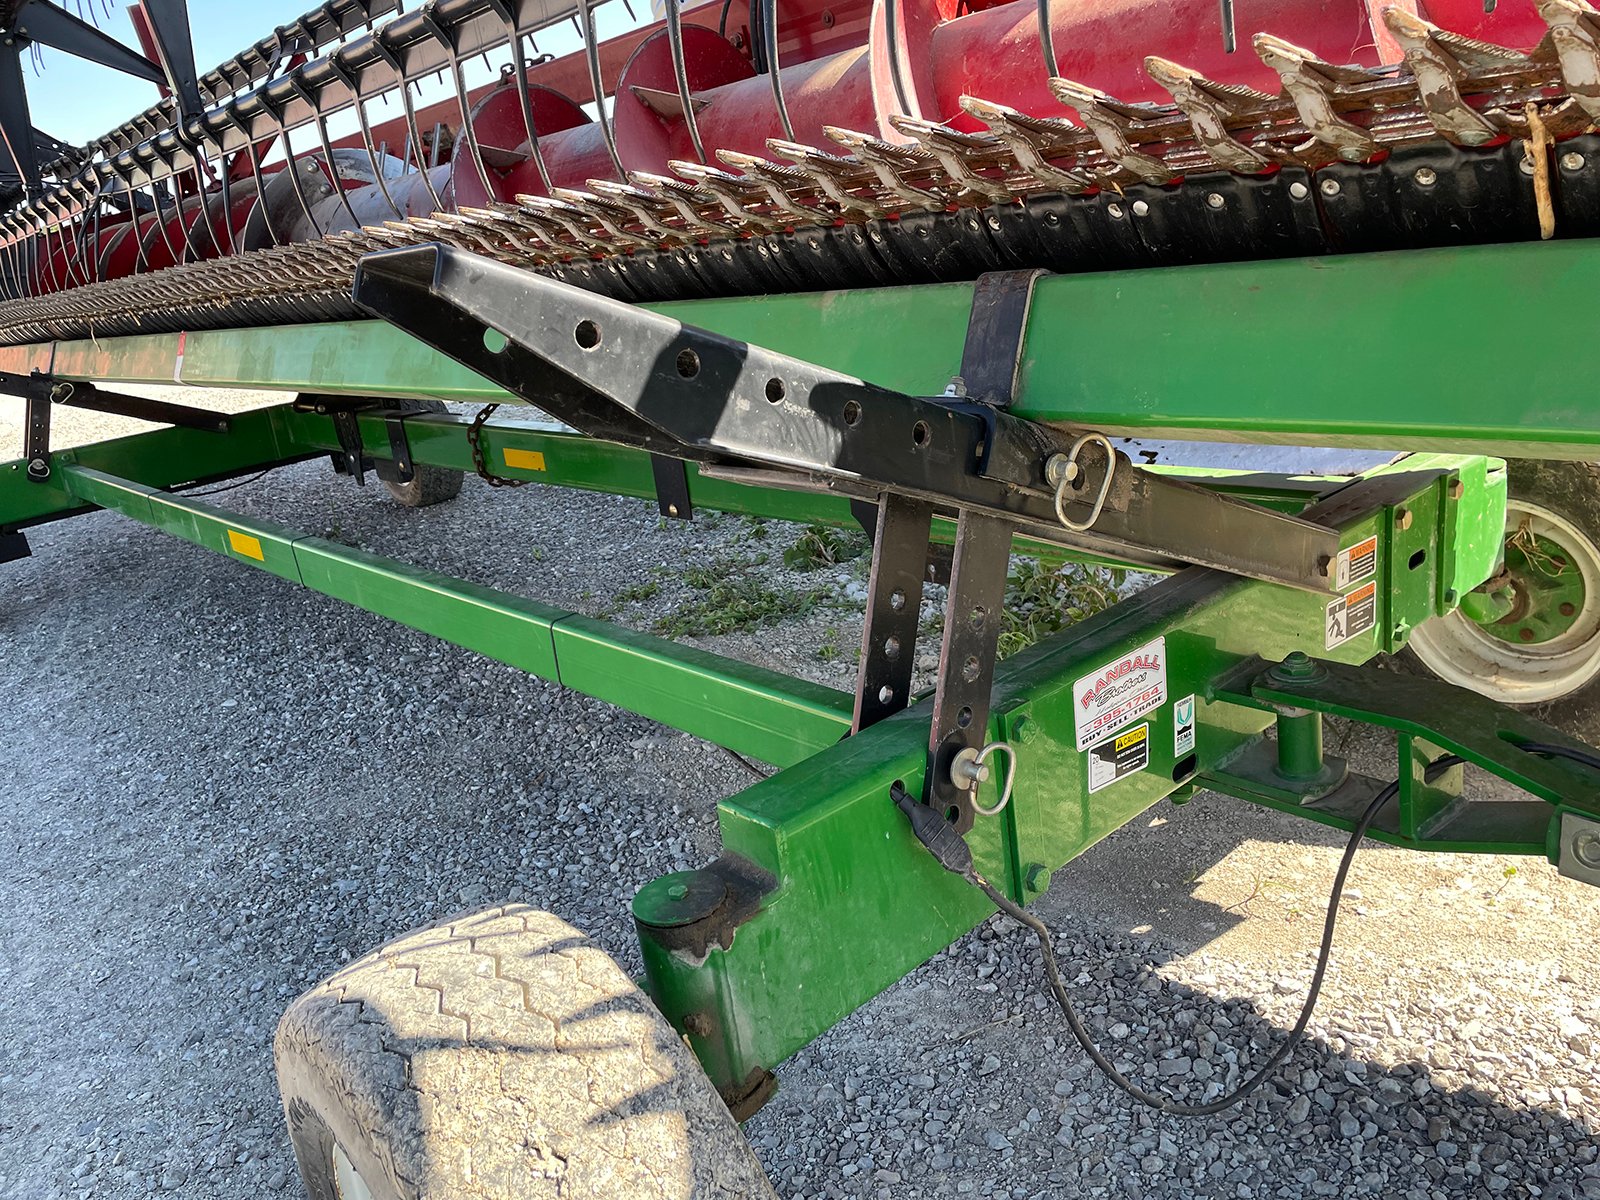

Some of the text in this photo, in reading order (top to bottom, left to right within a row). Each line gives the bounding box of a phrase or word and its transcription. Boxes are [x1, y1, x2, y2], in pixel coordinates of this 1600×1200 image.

[1081, 654, 1160, 709] RANDALL
[1081, 729, 1102, 746] BUY
[1107, 715, 1129, 731] SELL
[1134, 695, 1163, 715] TRADE
[1093, 687, 1159, 729] 395-1764
[1124, 730, 1146, 745] CAUTION
[1176, 731, 1192, 742] FEMA
